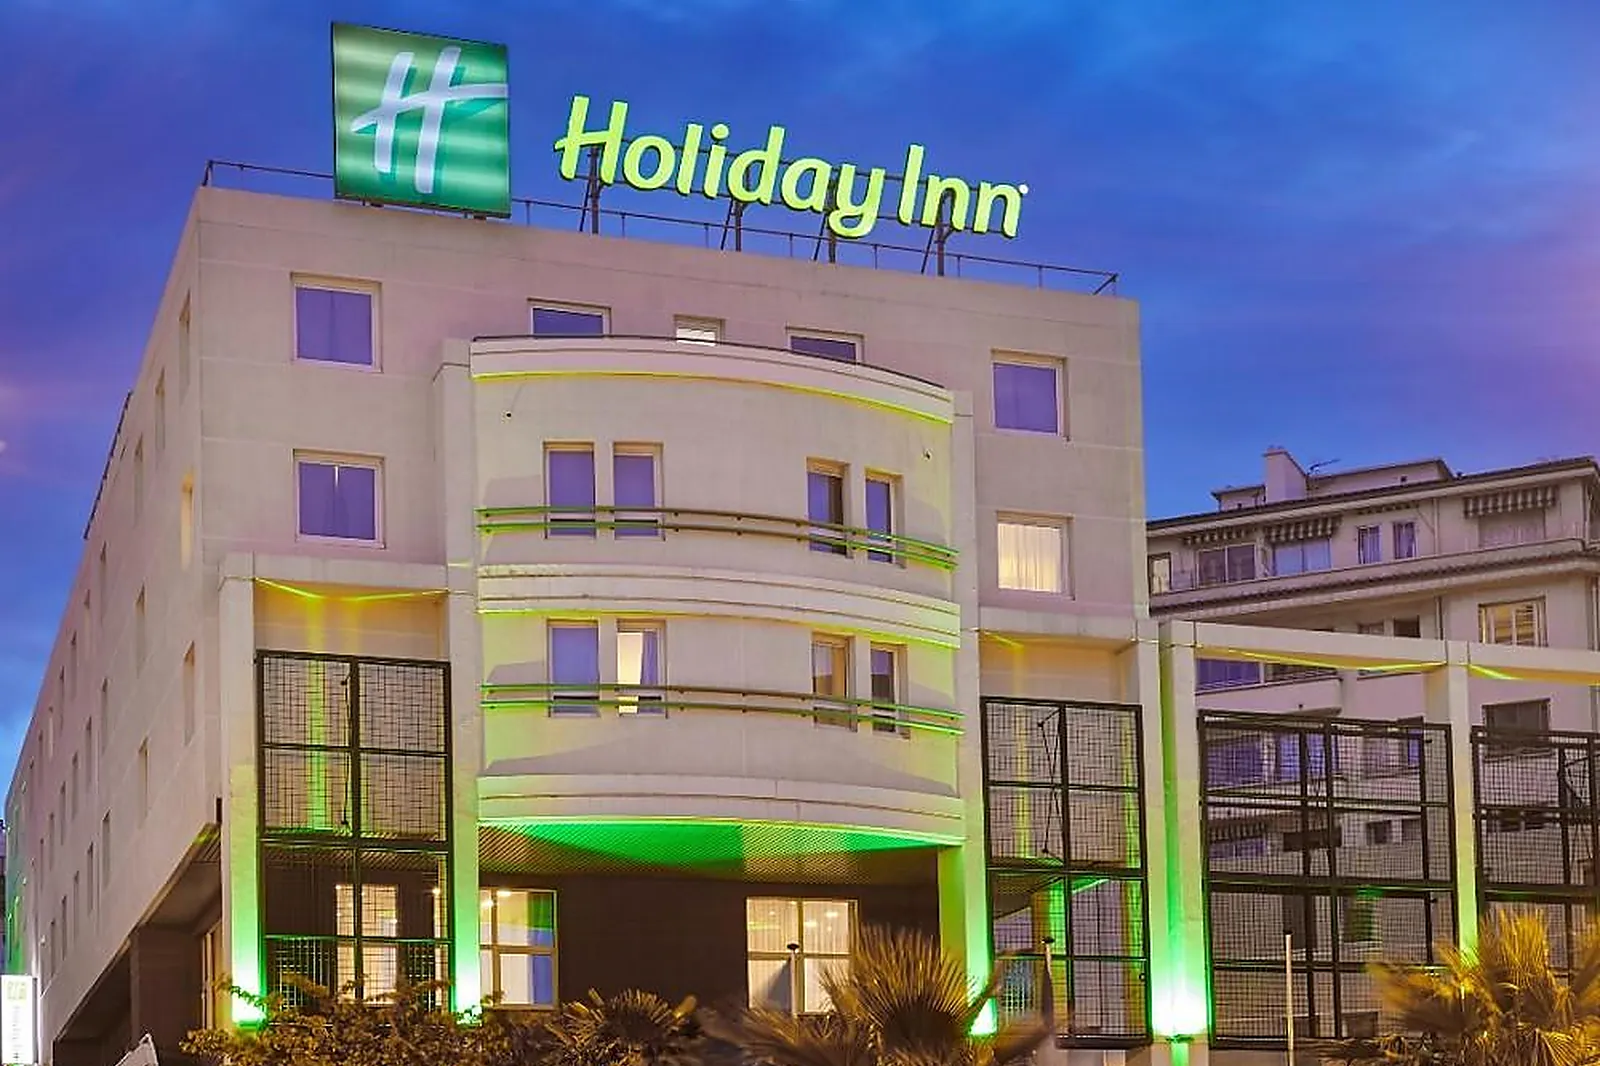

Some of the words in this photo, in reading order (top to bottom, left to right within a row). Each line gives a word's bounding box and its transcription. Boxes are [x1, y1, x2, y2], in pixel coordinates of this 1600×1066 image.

[351, 46, 509, 194] H
[554, 95, 884, 238] Holiday
[899, 144, 1022, 237] Inn
